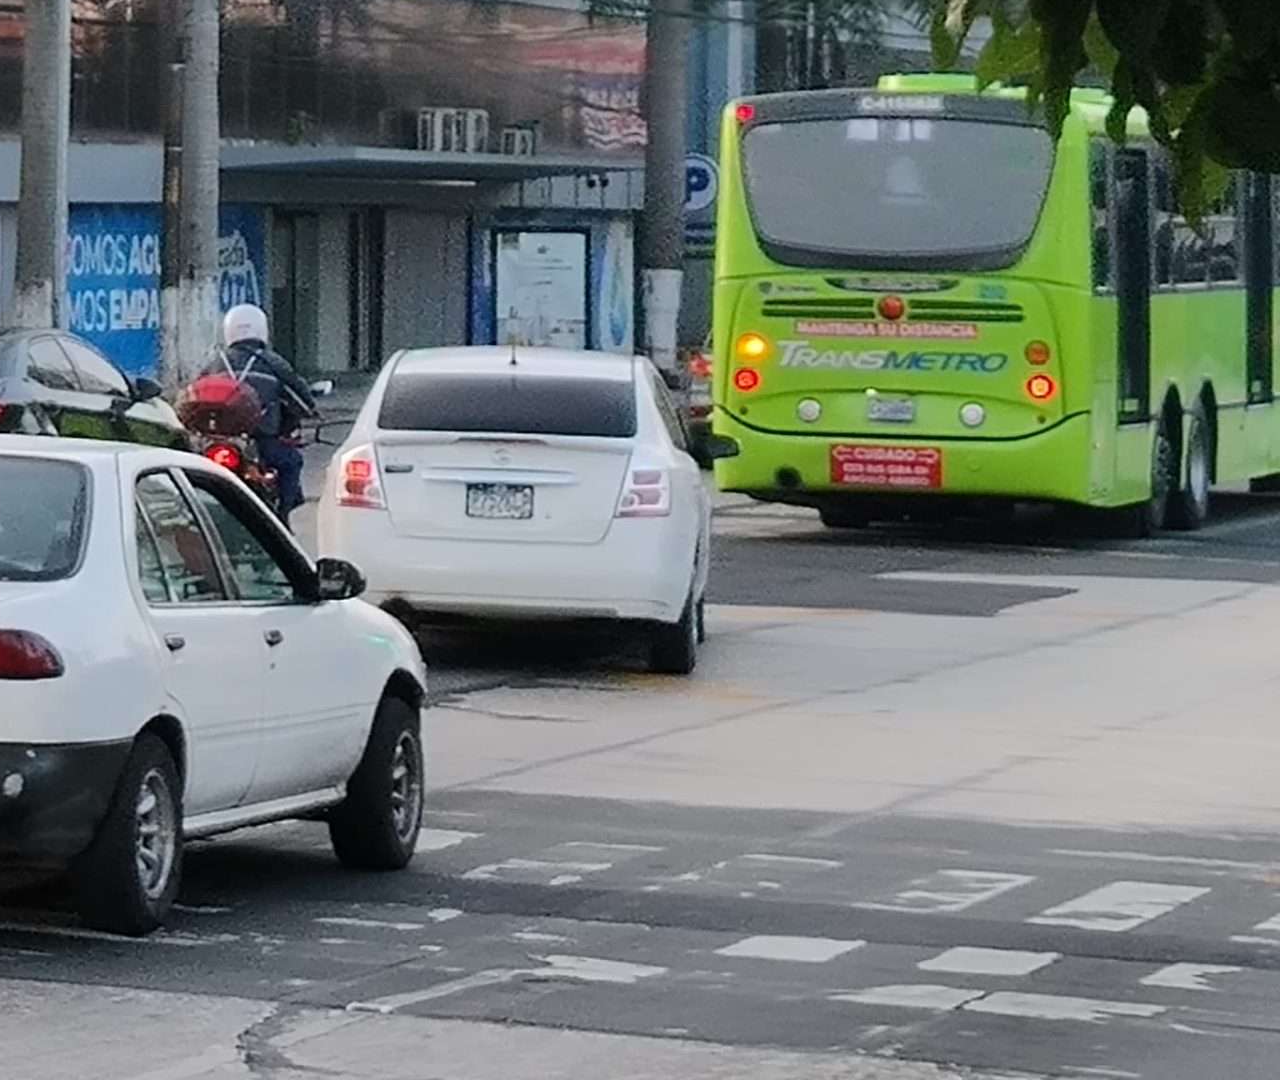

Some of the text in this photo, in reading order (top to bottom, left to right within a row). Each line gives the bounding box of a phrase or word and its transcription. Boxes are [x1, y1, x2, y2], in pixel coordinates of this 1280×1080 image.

[797, 322, 976, 338] MANTENGA SU DISTANCIA
